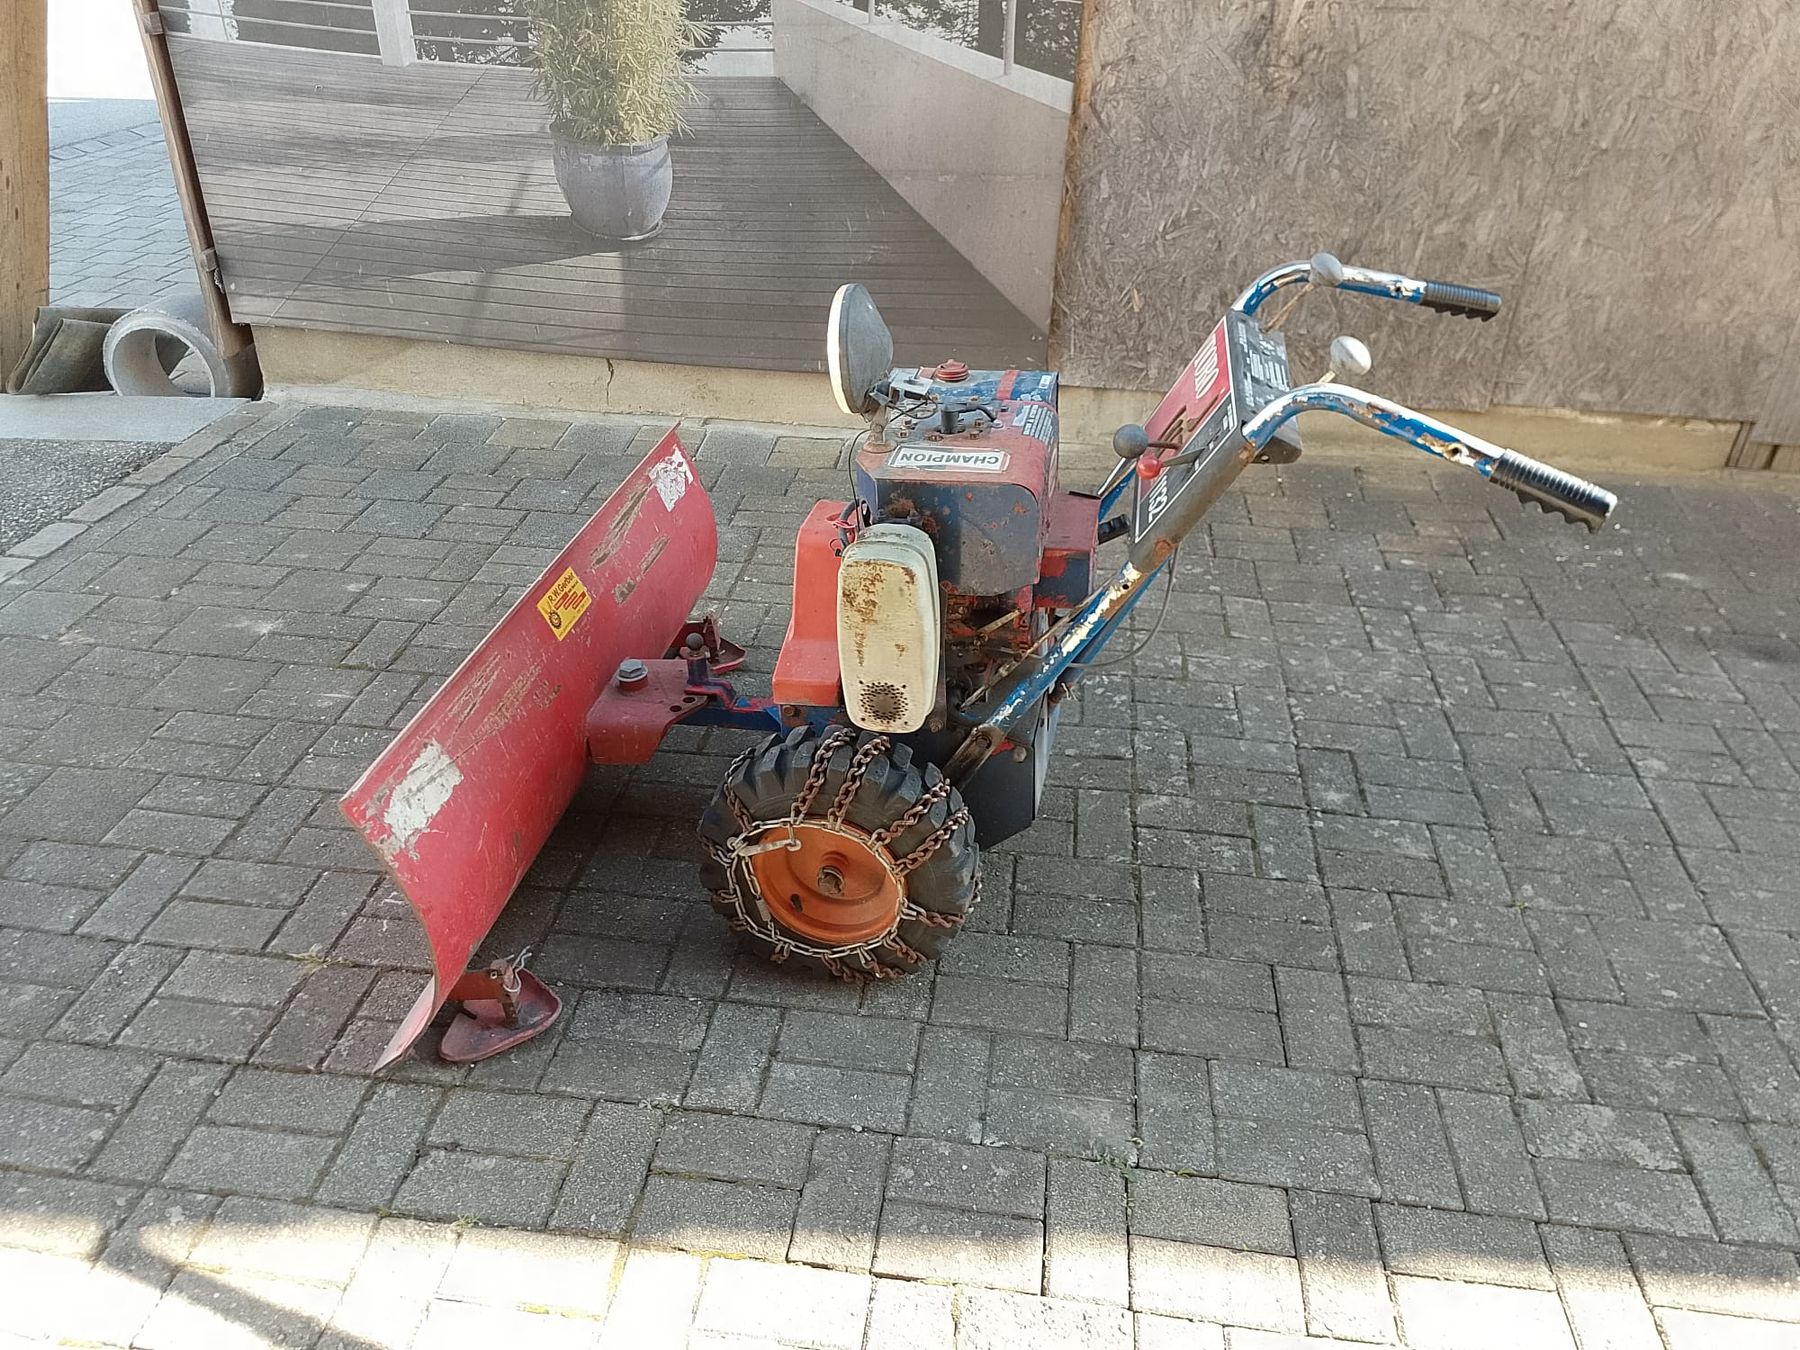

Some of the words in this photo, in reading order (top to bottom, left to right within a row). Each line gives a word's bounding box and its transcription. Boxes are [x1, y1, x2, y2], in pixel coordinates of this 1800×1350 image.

[1194, 333, 1219, 399] TORO
[900, 453, 1000, 465] CHAMPION
[1148, 475, 1168, 523] 1132
